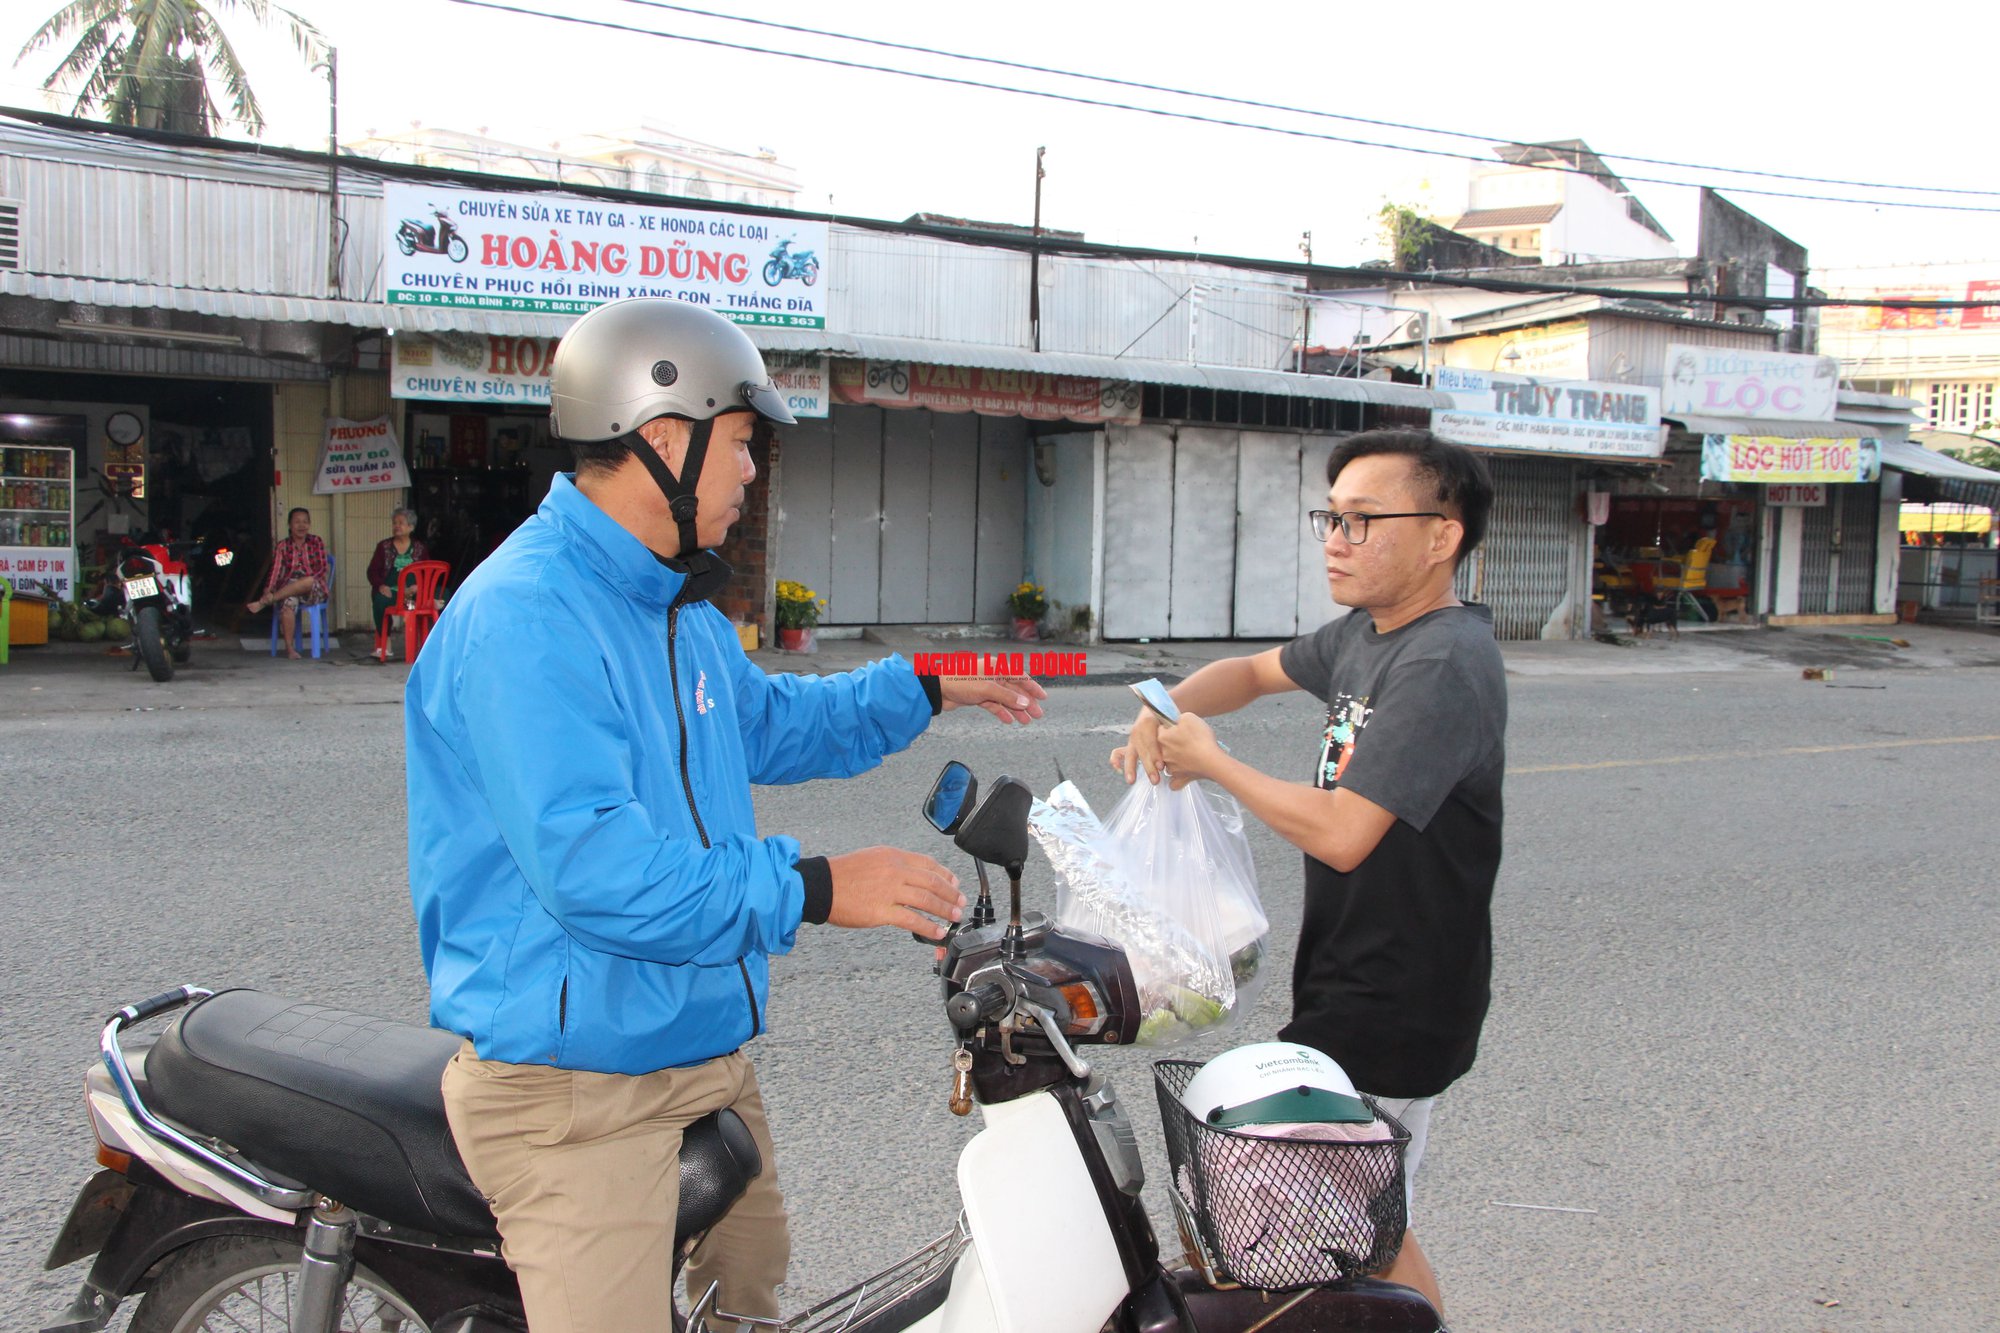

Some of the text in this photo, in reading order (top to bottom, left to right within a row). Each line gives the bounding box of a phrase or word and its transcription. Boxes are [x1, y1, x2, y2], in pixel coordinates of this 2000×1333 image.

[459, 199, 517, 219] CHUYÊN
[522, 201, 550, 222] SỬA
[555, 208, 572, 224] XE
[577, 210, 603, 226] TAY
[608, 212, 625, 228] GA
[639, 215, 656, 231] XE
[661, 217, 705, 235] HONDA
[709, 218, 735, 238] CÁC
[739, 226, 768, 244] LOẠI
[480, 229, 750, 283] HOÀNG DŨNG
[401, 272, 478, 290] CHUYÊN
[485, 278, 535, 296] PHỤC
[541, 277, 572, 296] HỒI
[578, 281, 620, 299] BÌNH
[678, 290, 711, 305] CON
[727, 290, 782, 310] THẮNG
[787, 296, 814, 312] ĐĨA
[419, 294, 431, 302] 10
[455, 294, 476, 305] HÒA
[478, 296, 503, 306] BÌNH
[512, 299, 525, 308] P3
[534, 300, 549, 310] TP.
[552, 301, 572, 312] BẠC
[760, 315, 785, 324] 141
[790, 317, 816, 326] 363
[488, 336, 562, 377] HOA
[406, 376, 476, 394] CHUYÊN
[482, 377, 515, 396] SỬA
[1702, 375, 1805, 416] LỘC
[788, 396, 818, 409] CON
[1566, 388, 1648, 424] TRANG
[326, 464, 346, 475] SỬA
[381, 461, 396, 470] ÁO
[330, 453, 362, 462] MAY
[1732, 441, 1852, 476] LỘC HỚT TÓC
[17, 560, 35, 572] CAM
[37, 557, 48, 572] ÉP
[51, 560, 65, 572] 10K
[56, 578, 68, 590] ME
[1255, 1057, 1320, 1070] Vietcombank
